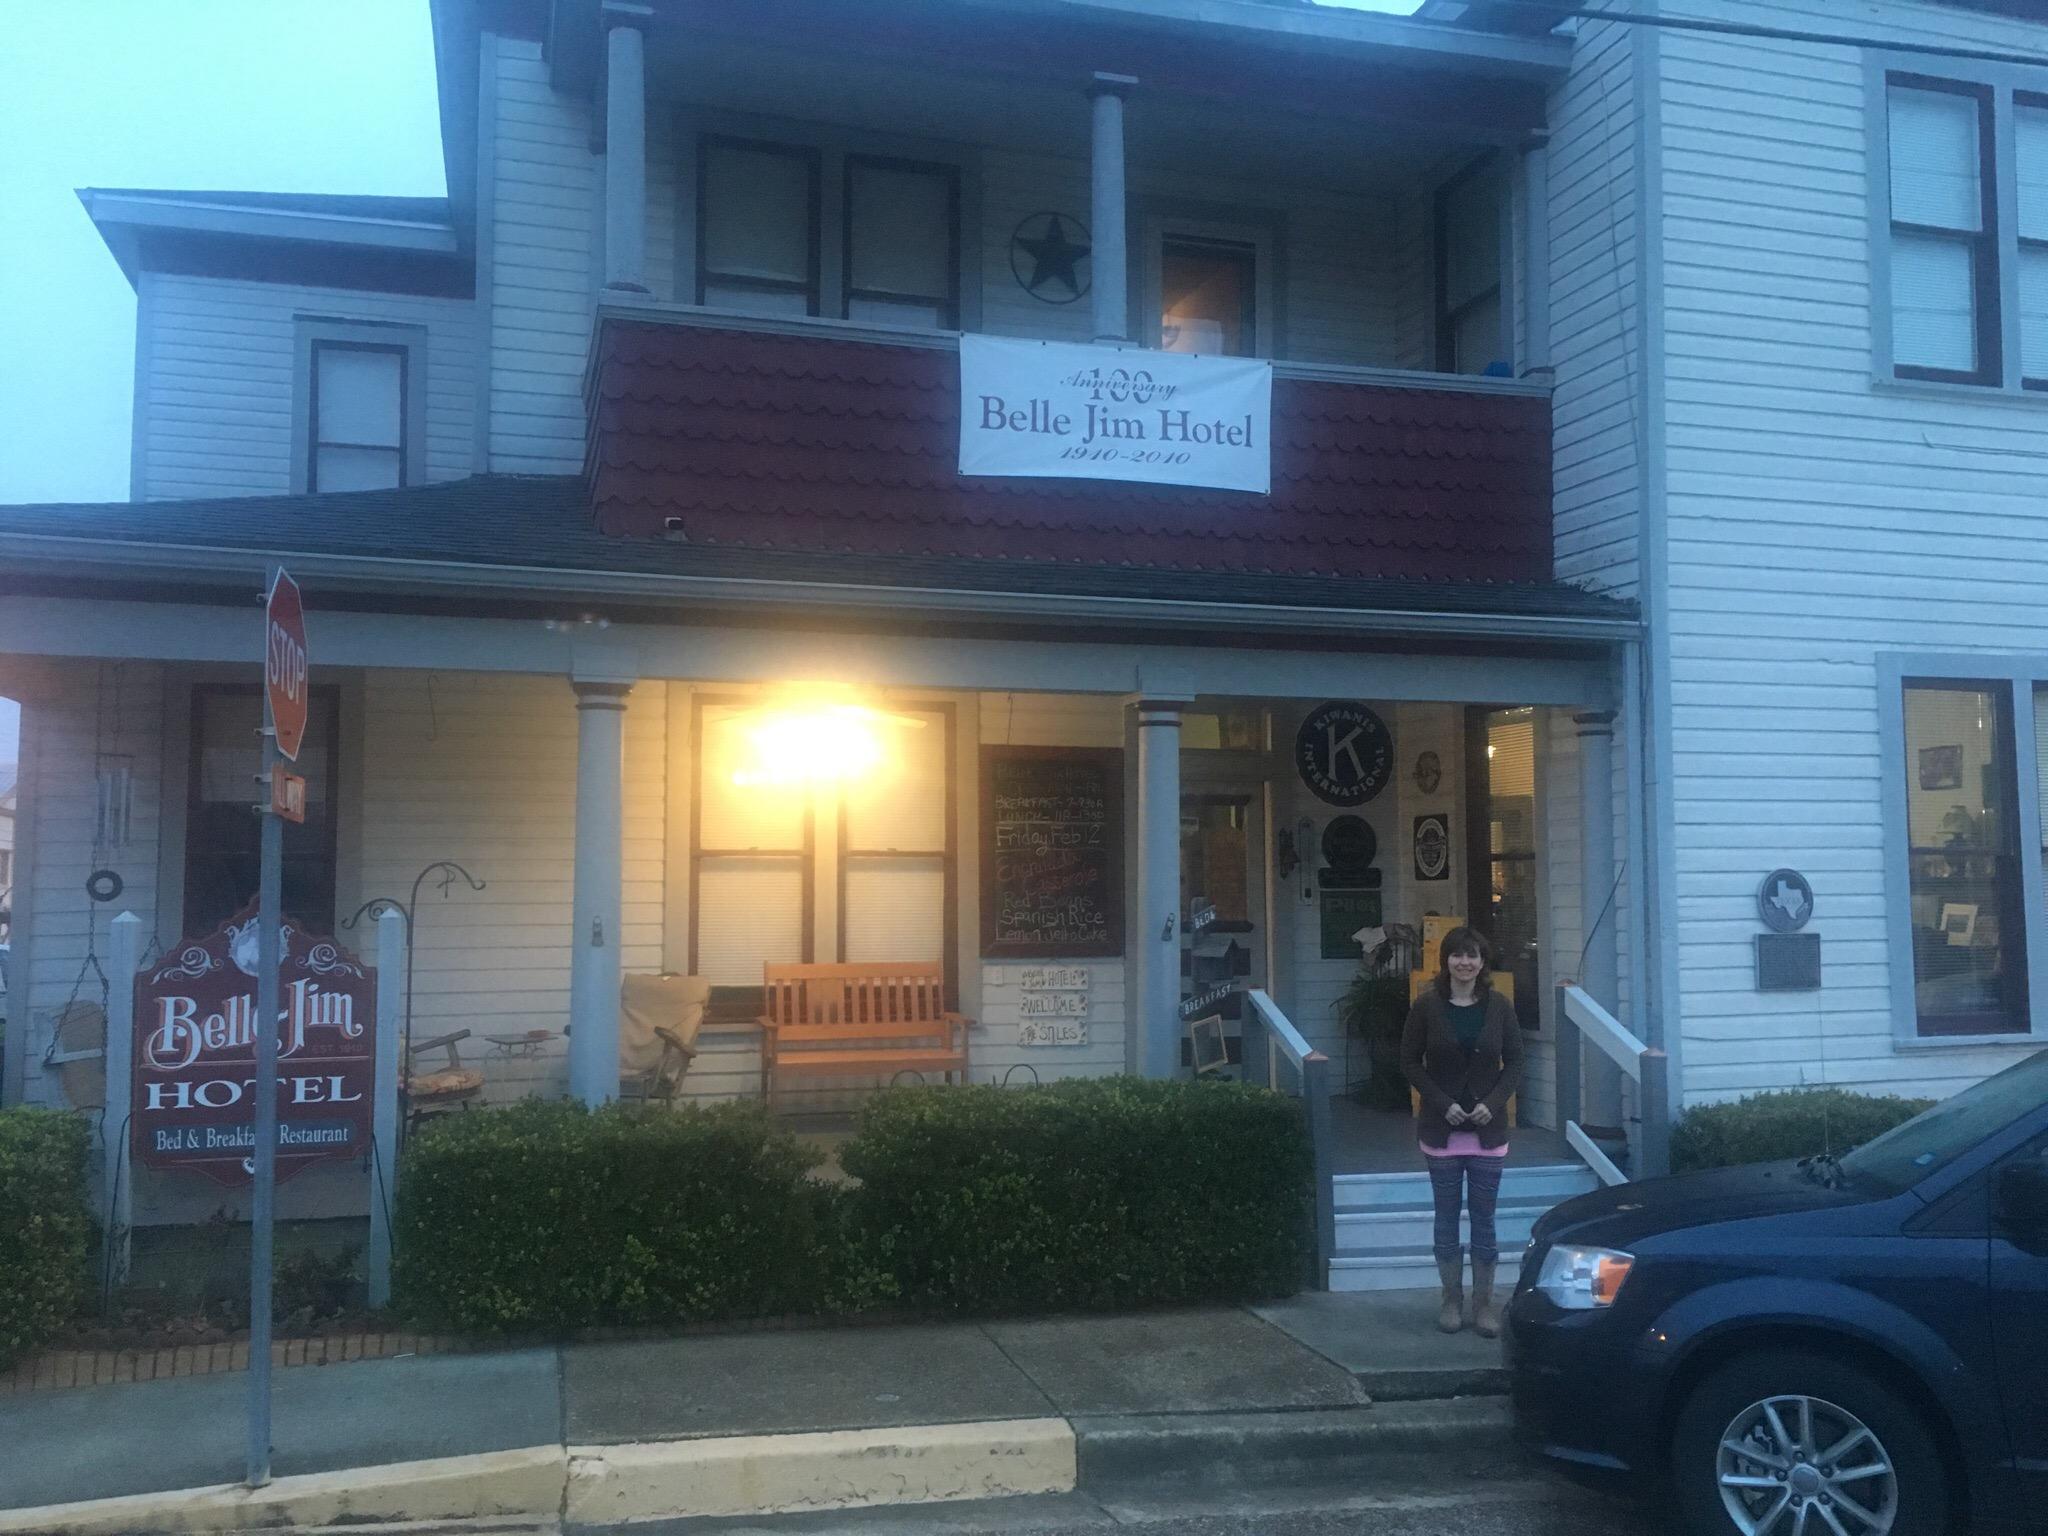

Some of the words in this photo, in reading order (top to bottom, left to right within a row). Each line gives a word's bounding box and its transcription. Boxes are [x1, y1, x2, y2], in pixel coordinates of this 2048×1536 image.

[1060, 370, 1181, 400] Anniversary
[1090, 368, 1153, 404] 100
[979, 395, 1071, 435] Belle
[1082, 403, 1146, 444] Jim
[1157, 409, 1253, 448] Hotel
[1060, 447, 1191, 465] 1910-2010
[270, 620, 305, 704] STOP
[1313, 710, 1376, 733] KIWANIS
[1327, 720, 1367, 782] K
[1305, 743, 1385, 797] INTERNATIONAL
[995, 920, 1041, 941] Lemon
[1000, 908, 1066, 928] Spanish
[1068, 904, 1105, 927] Rice
[157, 1128, 181, 1150] Bed
[187, 1128, 200, 1149] &
[206, 1126, 256, 1149] Breakfa
[279, 1124, 349, 1145] Restaurant
